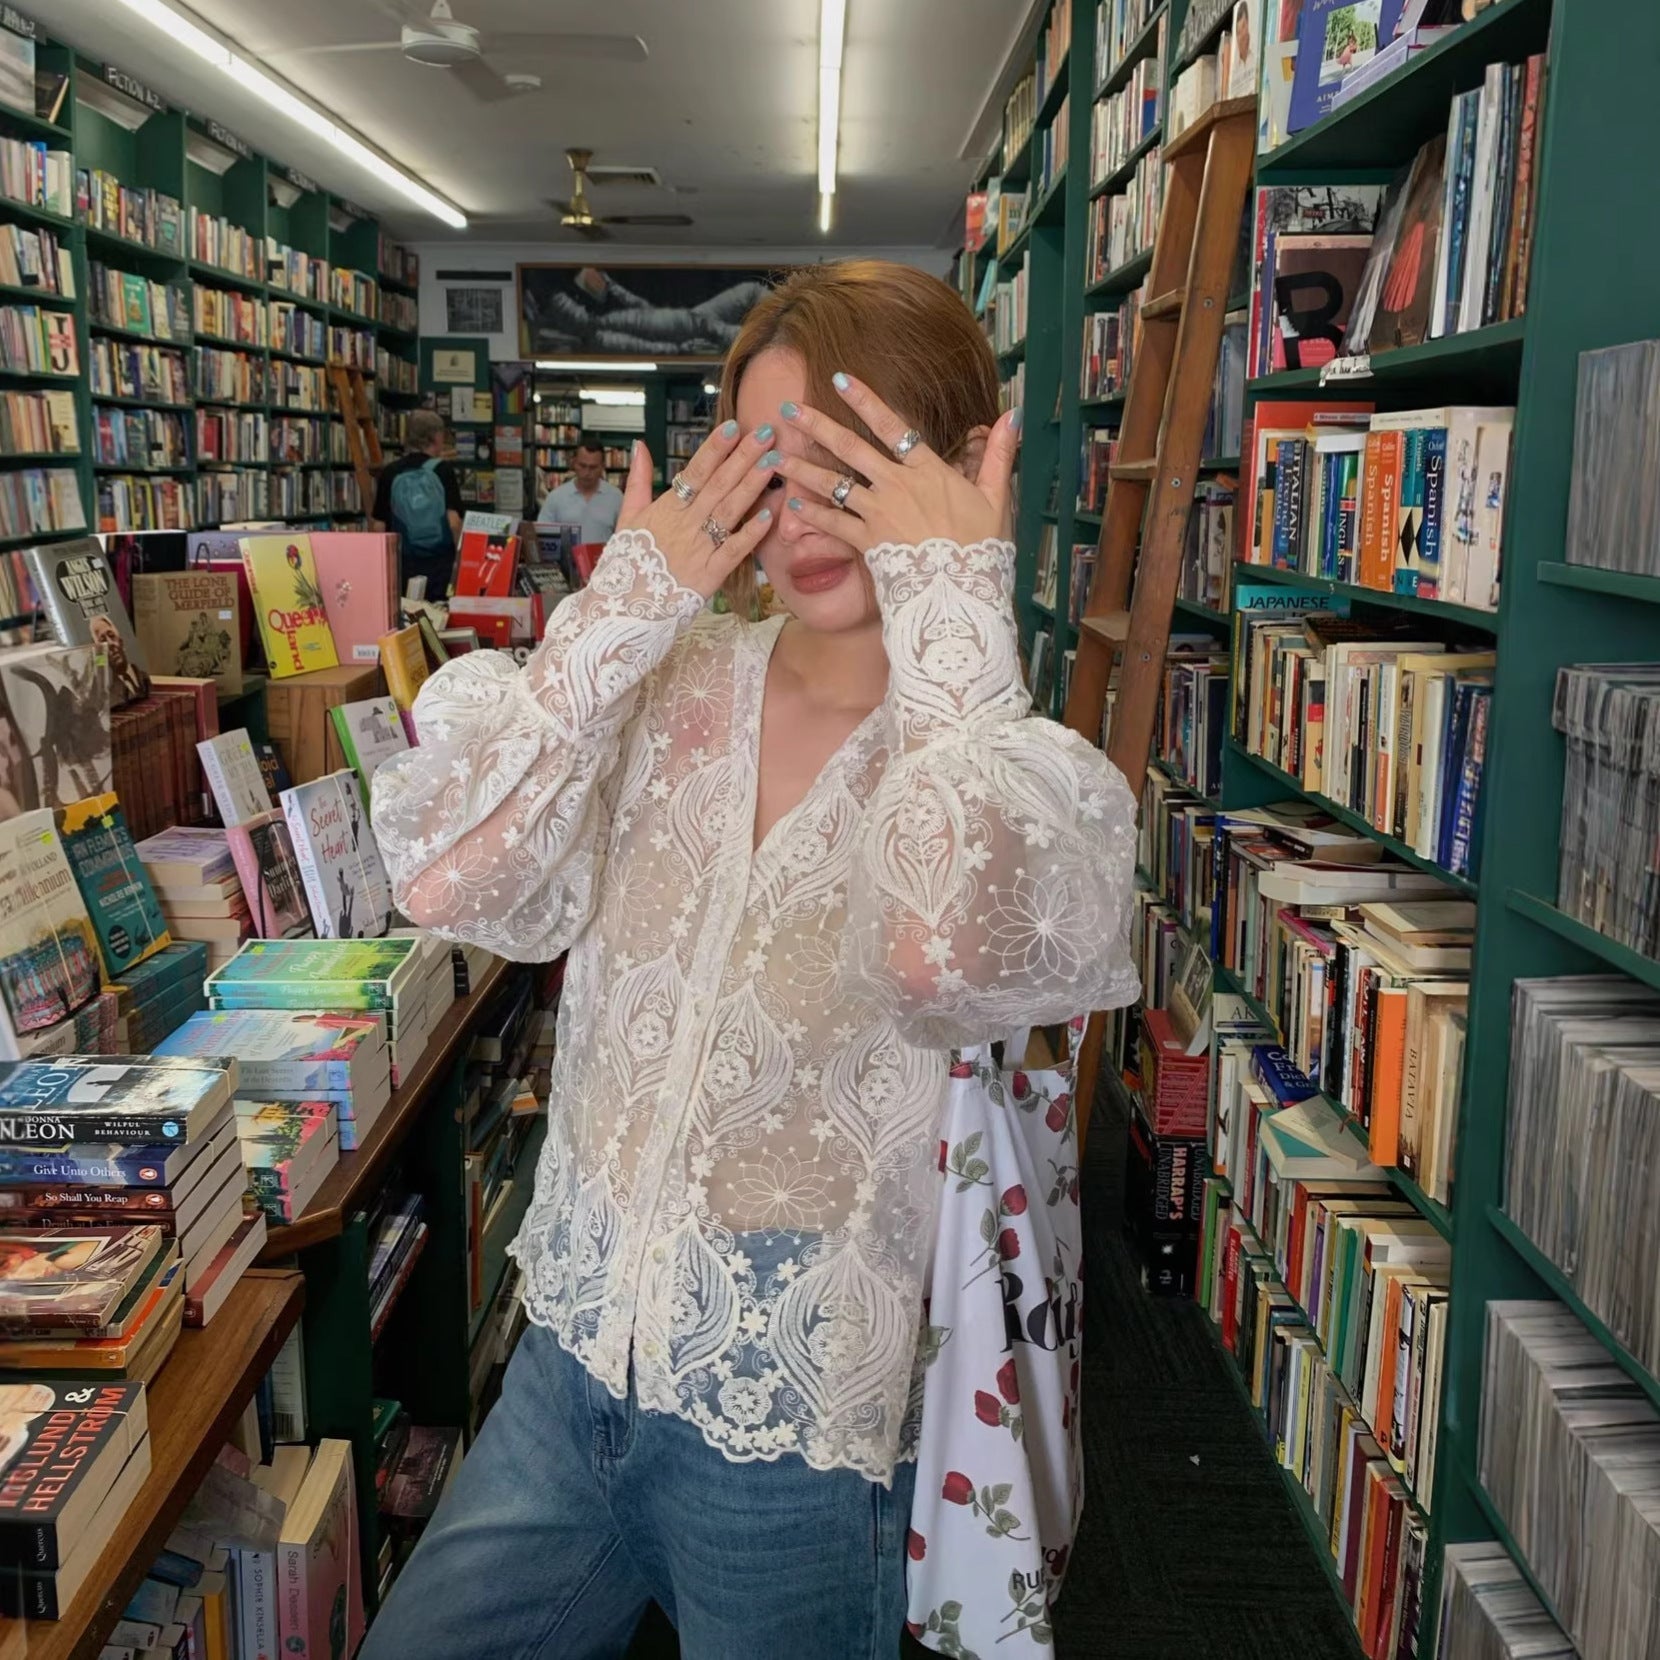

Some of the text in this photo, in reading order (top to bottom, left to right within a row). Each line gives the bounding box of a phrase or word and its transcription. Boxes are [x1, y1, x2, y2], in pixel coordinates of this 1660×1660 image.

[108, 67, 144, 100] FICTION
[1289, 454, 1300, 540] ITALIAN
[1365, 464, 1378, 546] Spanish
[1425, 455, 1442, 557] Spanish
[1380, 473, 1393, 563] Spanish
[60, 571, 107, 600] WILSON
[165, 576, 228, 589] THE LONE
[169, 586, 231, 600] GUIDE OF
[174, 598, 235, 612] MERFIELD
[1245, 596, 1330, 609] JAPANESE
[310, 799, 344, 837] Secret
[321, 831, 348, 864] Heart
[1405, 1048, 1418, 1119] BATAVIA
[33, 1164, 127, 1178] Give Unto Others
[1155, 1149, 1173, 1220] UNABRIDGED
[1169, 1147, 1188, 1220] HARRAP'S
[45, 1192, 128, 1205] So Shall You Reap
[65, 1387, 96, 1403] &
[36, 1528, 47, 1562] Quercus
[287, 1550, 300, 1584] Sarah
[254, 1569, 266, 1650] SOPHIE KINSELLA
